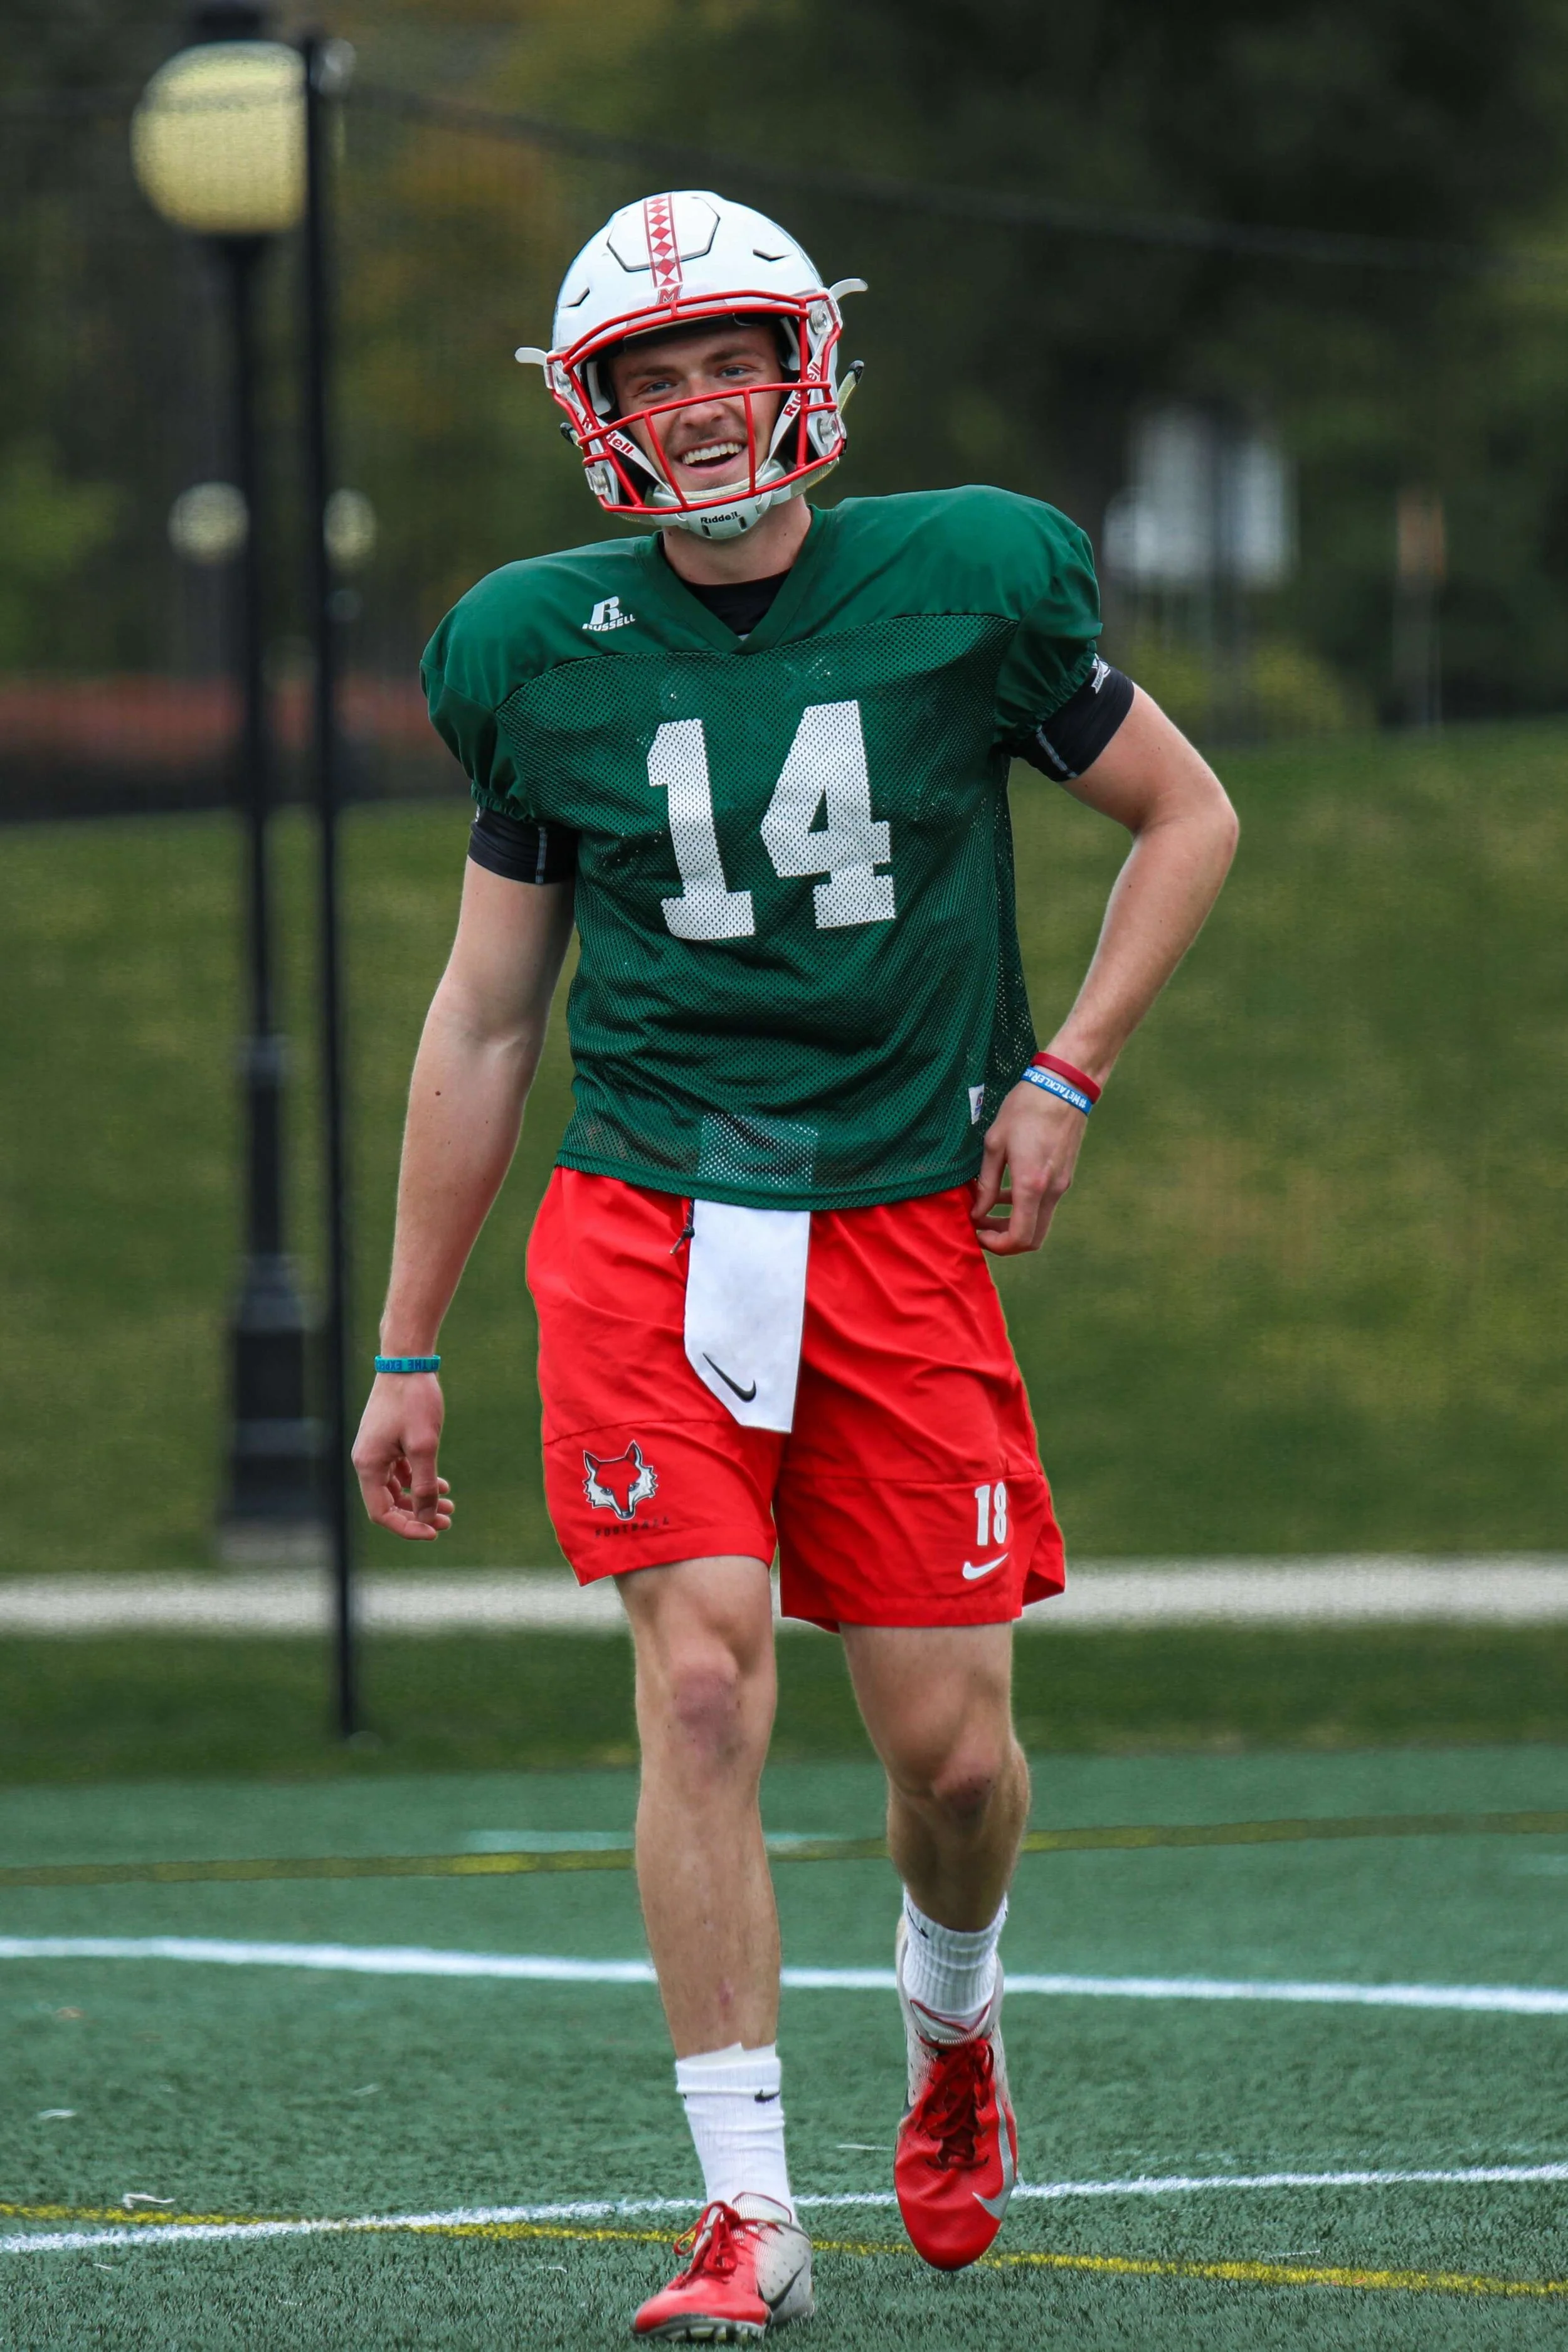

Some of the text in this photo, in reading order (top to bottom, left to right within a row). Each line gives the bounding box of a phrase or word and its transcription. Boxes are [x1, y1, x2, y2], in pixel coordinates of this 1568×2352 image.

[656, 284, 683, 306] M
[582, 614, 636, 631] RUSSELL
[647, 699, 896, 941] 14
[408, 1359, 428, 1371] THE
[974, 1481, 1007, 1546] 18
[595, 1517, 669, 1537] FOOTBALL
